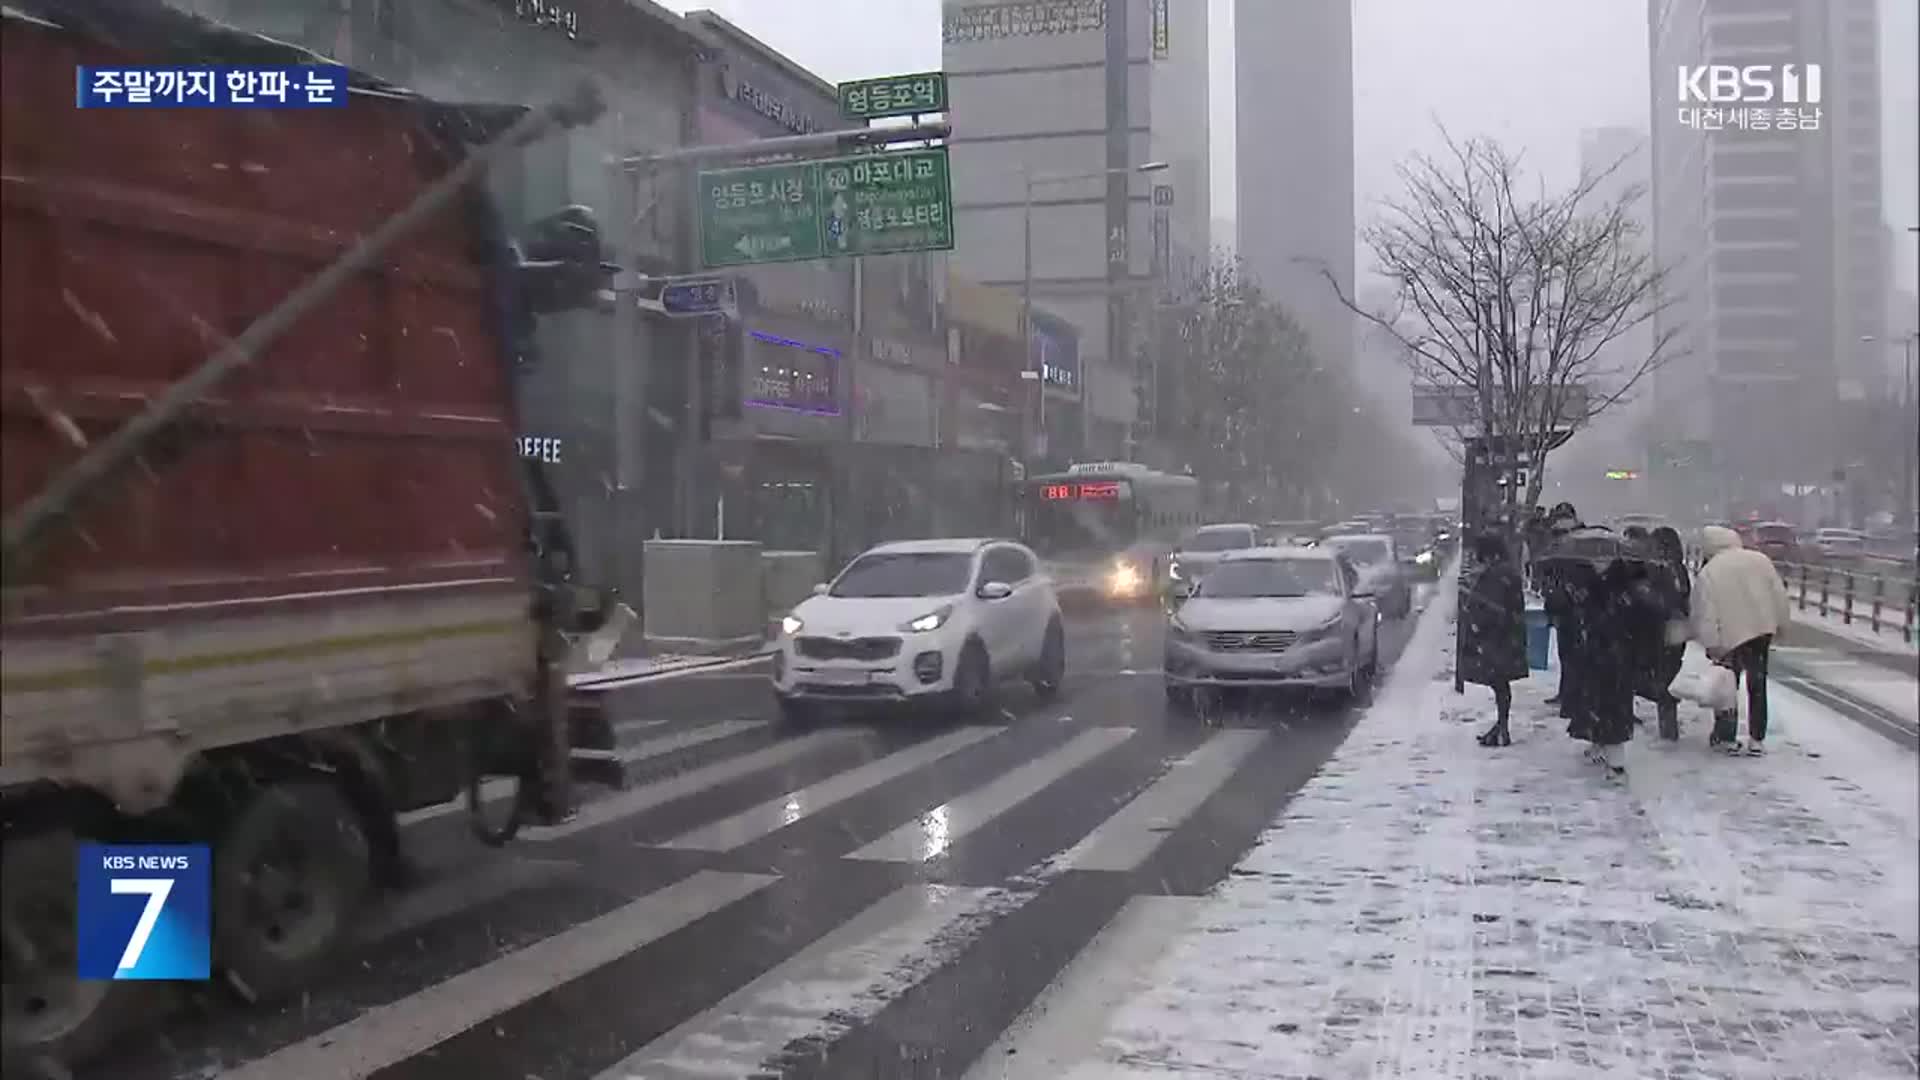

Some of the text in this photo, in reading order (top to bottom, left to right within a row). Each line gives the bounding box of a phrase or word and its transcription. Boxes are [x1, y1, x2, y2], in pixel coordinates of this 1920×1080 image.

[848, 78, 935, 113] 영등포역
[853, 156, 936, 184] 마포대교
[711, 178, 805, 209] 영등포시장
